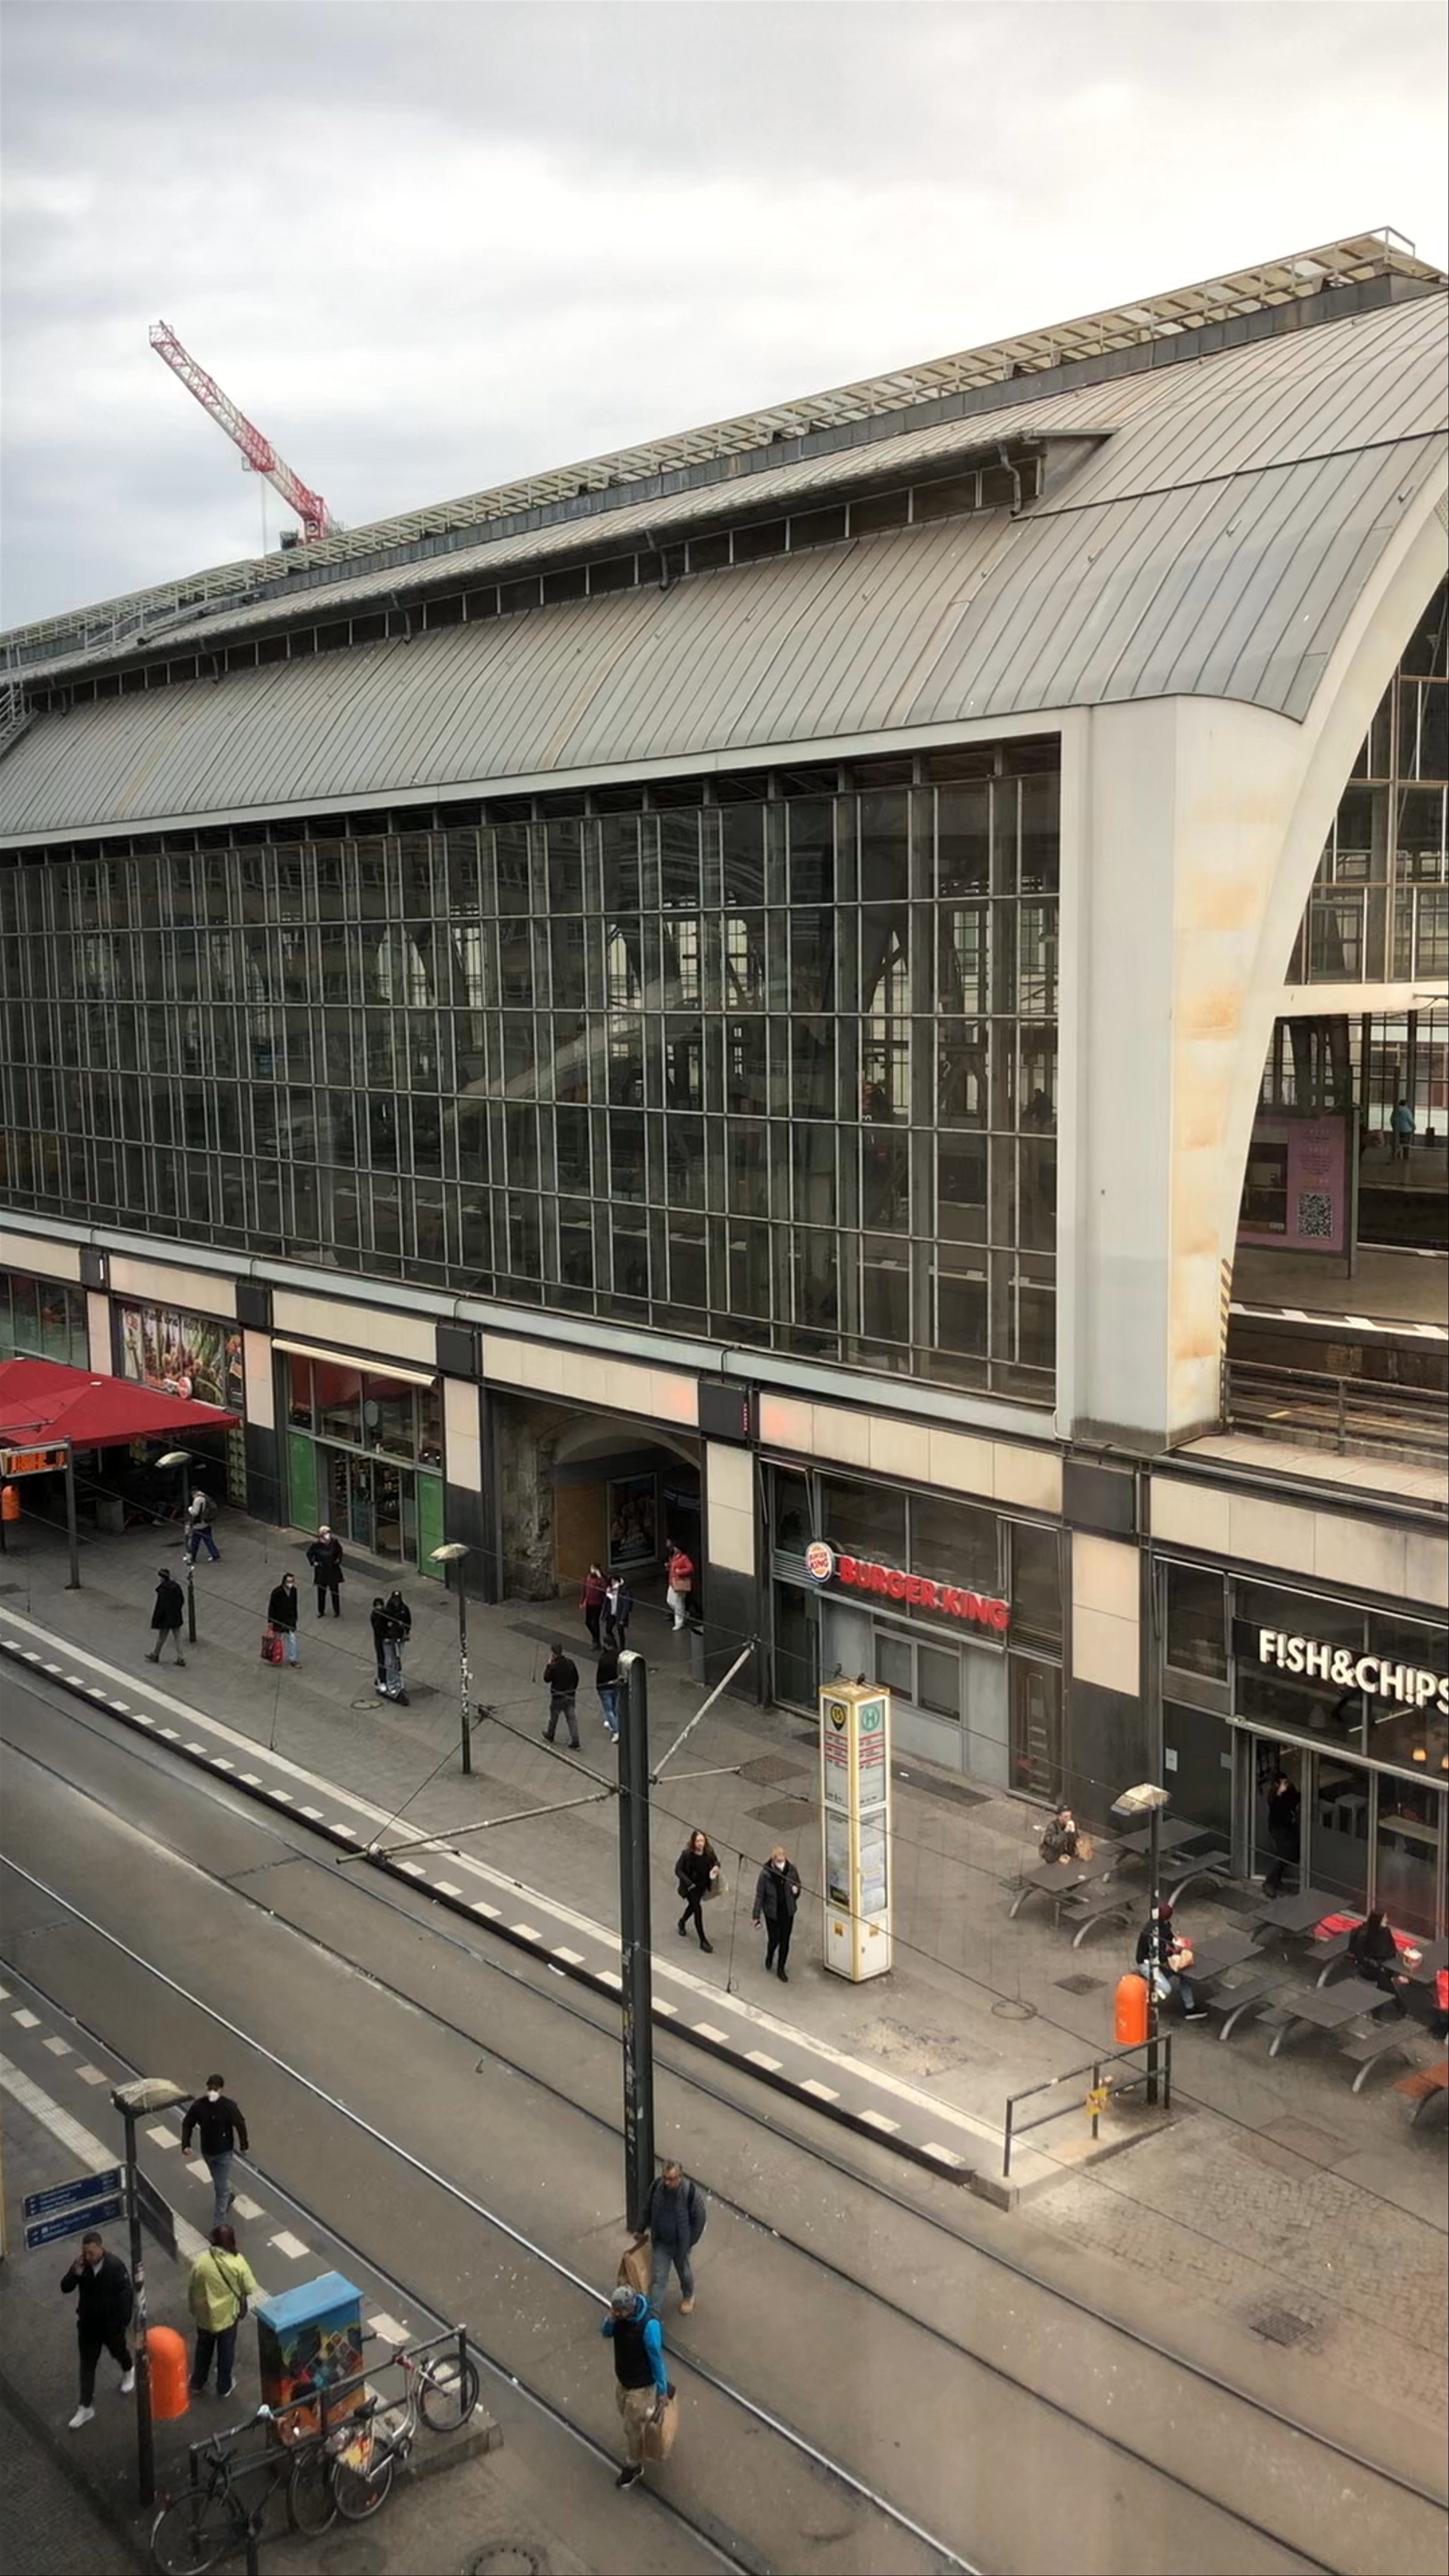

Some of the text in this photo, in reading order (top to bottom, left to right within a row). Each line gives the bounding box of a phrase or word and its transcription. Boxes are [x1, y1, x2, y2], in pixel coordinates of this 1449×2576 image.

[811, 1559, 829, 1569] KING
[839, 1555, 1010, 1631] BURGER KING
